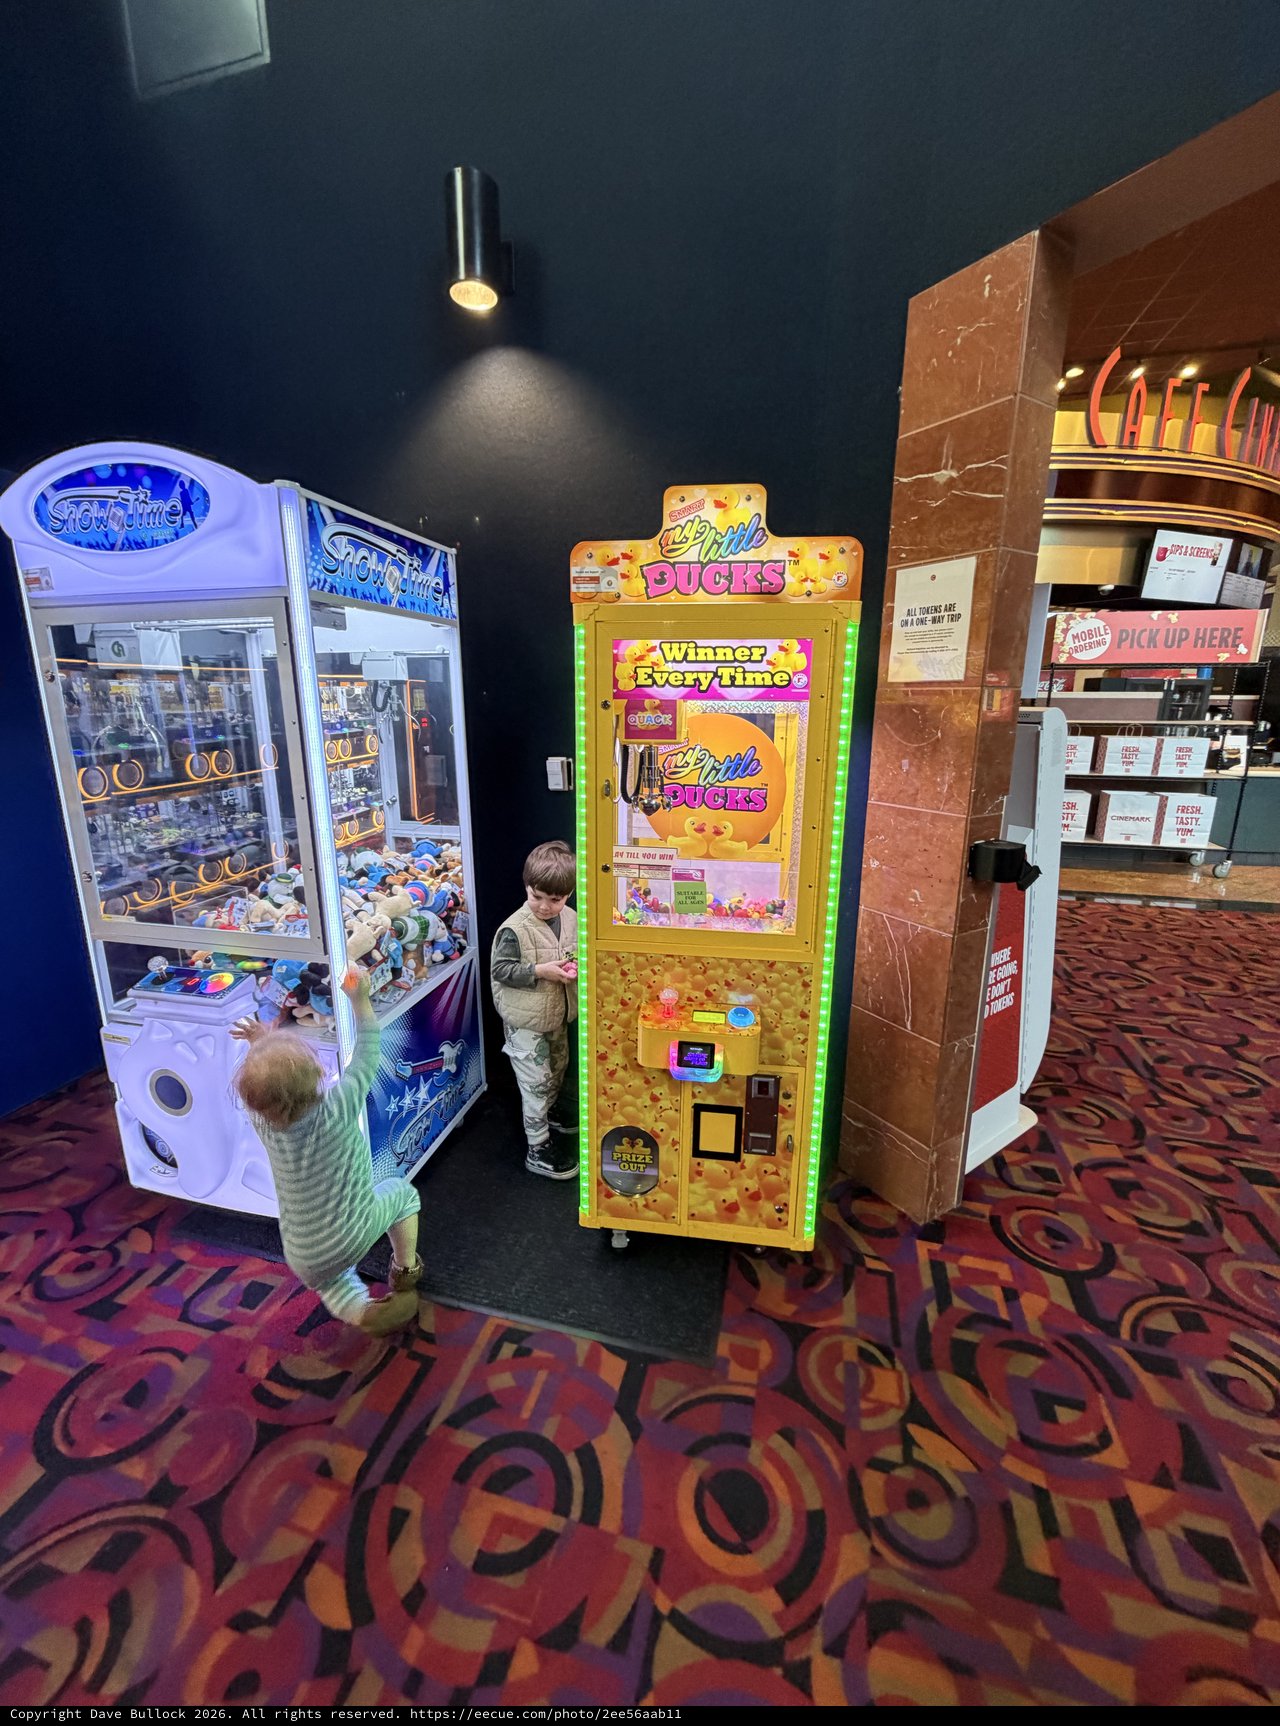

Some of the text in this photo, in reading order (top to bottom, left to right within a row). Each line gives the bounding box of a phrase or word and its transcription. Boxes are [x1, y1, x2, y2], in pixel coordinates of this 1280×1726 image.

[669, 499, 705, 522] SMART
[660, 513, 768, 562] my little
[1170, 543, 1184, 556] SIPS
[1183, 546, 1190, 556] &
[640, 560, 786, 600] DUCKS
[906, 602, 957, 617] ALL TOKENS ARE
[900, 613, 962, 628] ON A ONE-WAY TRIP
[1068, 625, 1110, 656] MOBILE ORDERING
[1117, 627, 1244, 649] PICK UP HERE
[660, 641, 765, 663] Winner
[635, 667, 714, 692] Every
[716, 667, 790, 688] Time
[627, 713, 672, 726] QUACK
[1175, 746, 1194, 754] FRESH.
[663, 745, 762, 785] my little
[664, 783, 768, 812] DUCKS
[1111, 815, 1152, 823] CINEMARK
[1176, 805, 1204, 815] FRESH.
[1175, 816, 1201, 826] TASTY.
[1176, 827, 1195, 837] YUM.
[642, 852, 657, 860] YOU
[659, 853, 674, 861] WIN
[996, 960, 1018, 981] GOING,
[990, 978, 1011, 1000] DON'T
[990, 992, 1015, 1016] TOKENS
[612, 1152, 654, 1164] PRIZE
[619, 1162, 646, 1172] OUT
